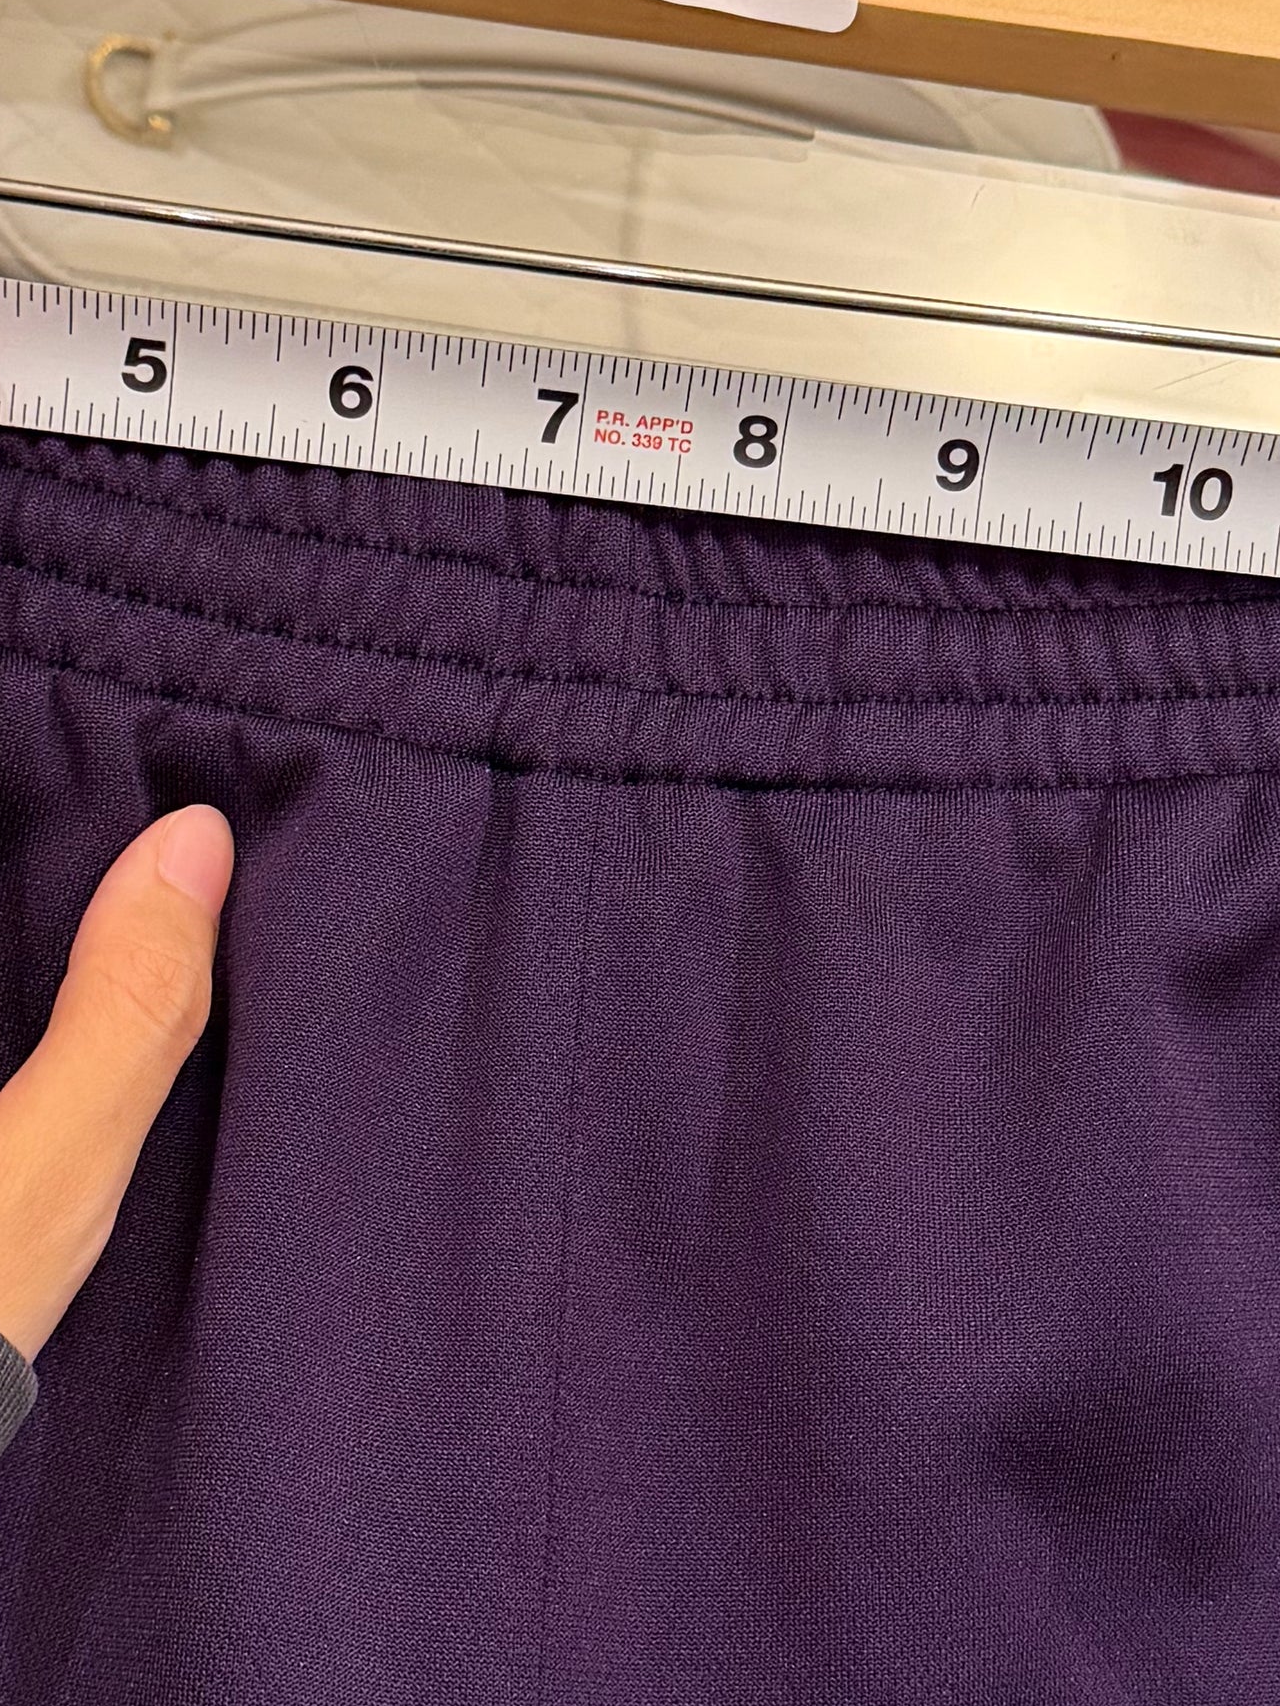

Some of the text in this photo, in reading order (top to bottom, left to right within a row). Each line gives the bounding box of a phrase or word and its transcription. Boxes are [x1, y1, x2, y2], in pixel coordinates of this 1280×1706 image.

[120, 337, 168, 393] 5
[328, 365, 374, 419] 6
[536, 388, 579, 444] 7
[594, 428, 625, 445] NO.
[668, 437, 692, 453] TC
[596, 410, 693, 434] P.R. APP'D
[732, 415, 778, 468] 8
[936, 439, 979, 492] 9
[1153, 463, 1234, 521] 10
